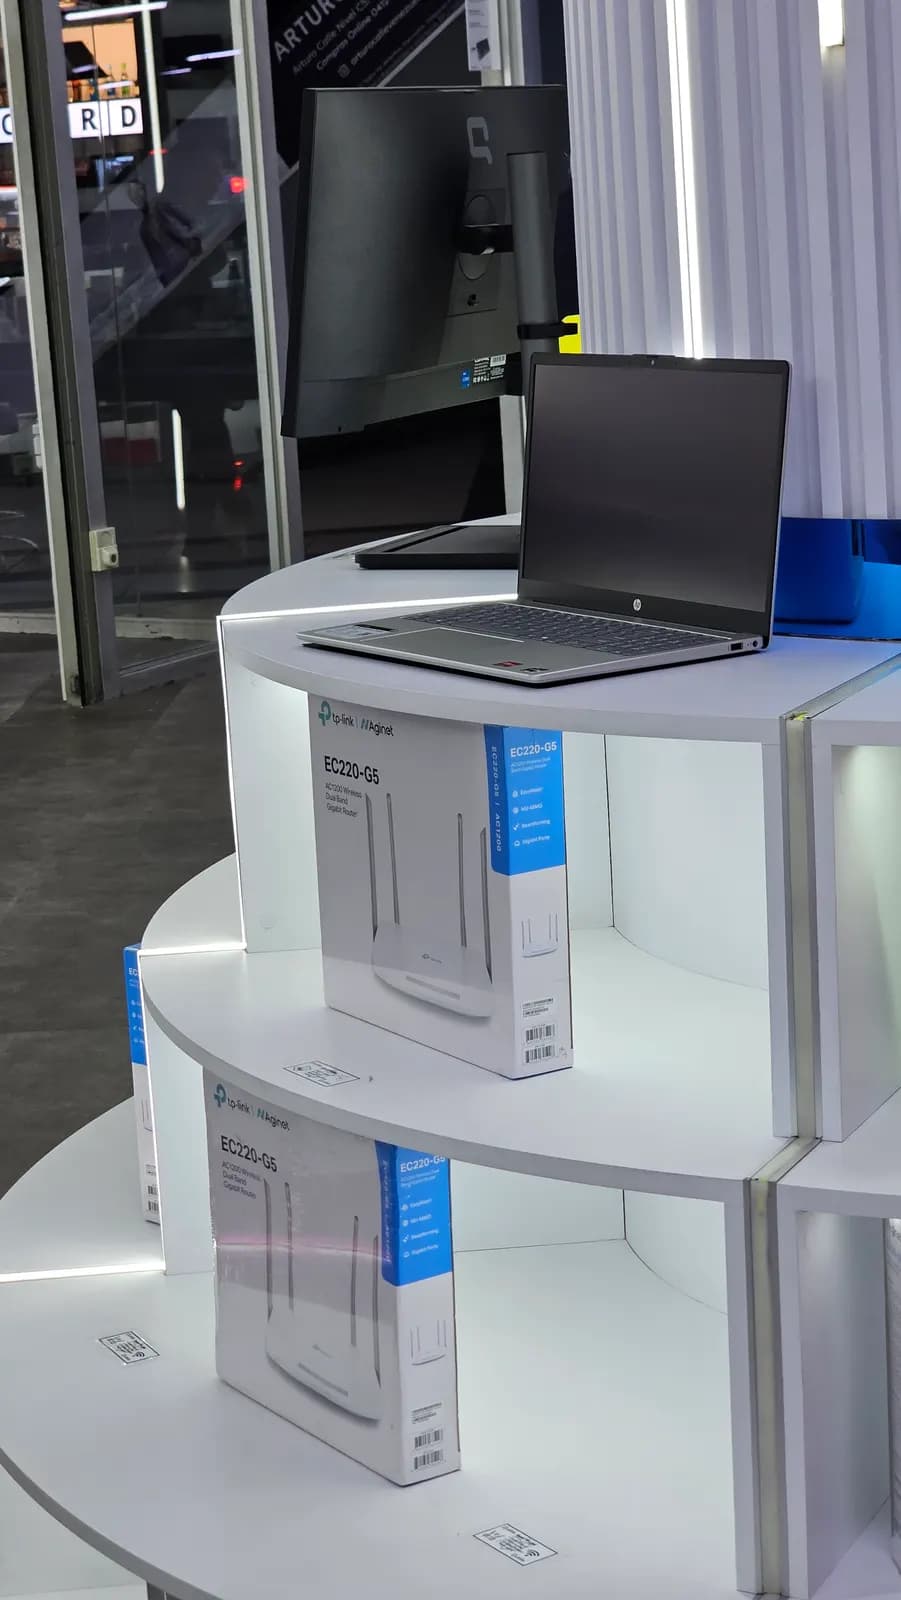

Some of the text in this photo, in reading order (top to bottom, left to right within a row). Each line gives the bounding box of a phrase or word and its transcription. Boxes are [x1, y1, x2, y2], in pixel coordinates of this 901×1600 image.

[274, 0, 341, 62] ARTUR
[332, 713, 355, 727] tp-link
[510, 741, 558, 758] EC220-G5
[323, 755, 380, 785] EC220-G5
[220, 1135, 277, 1172] EC220-G5
[400, 1155, 446, 1173] EC220-G5
